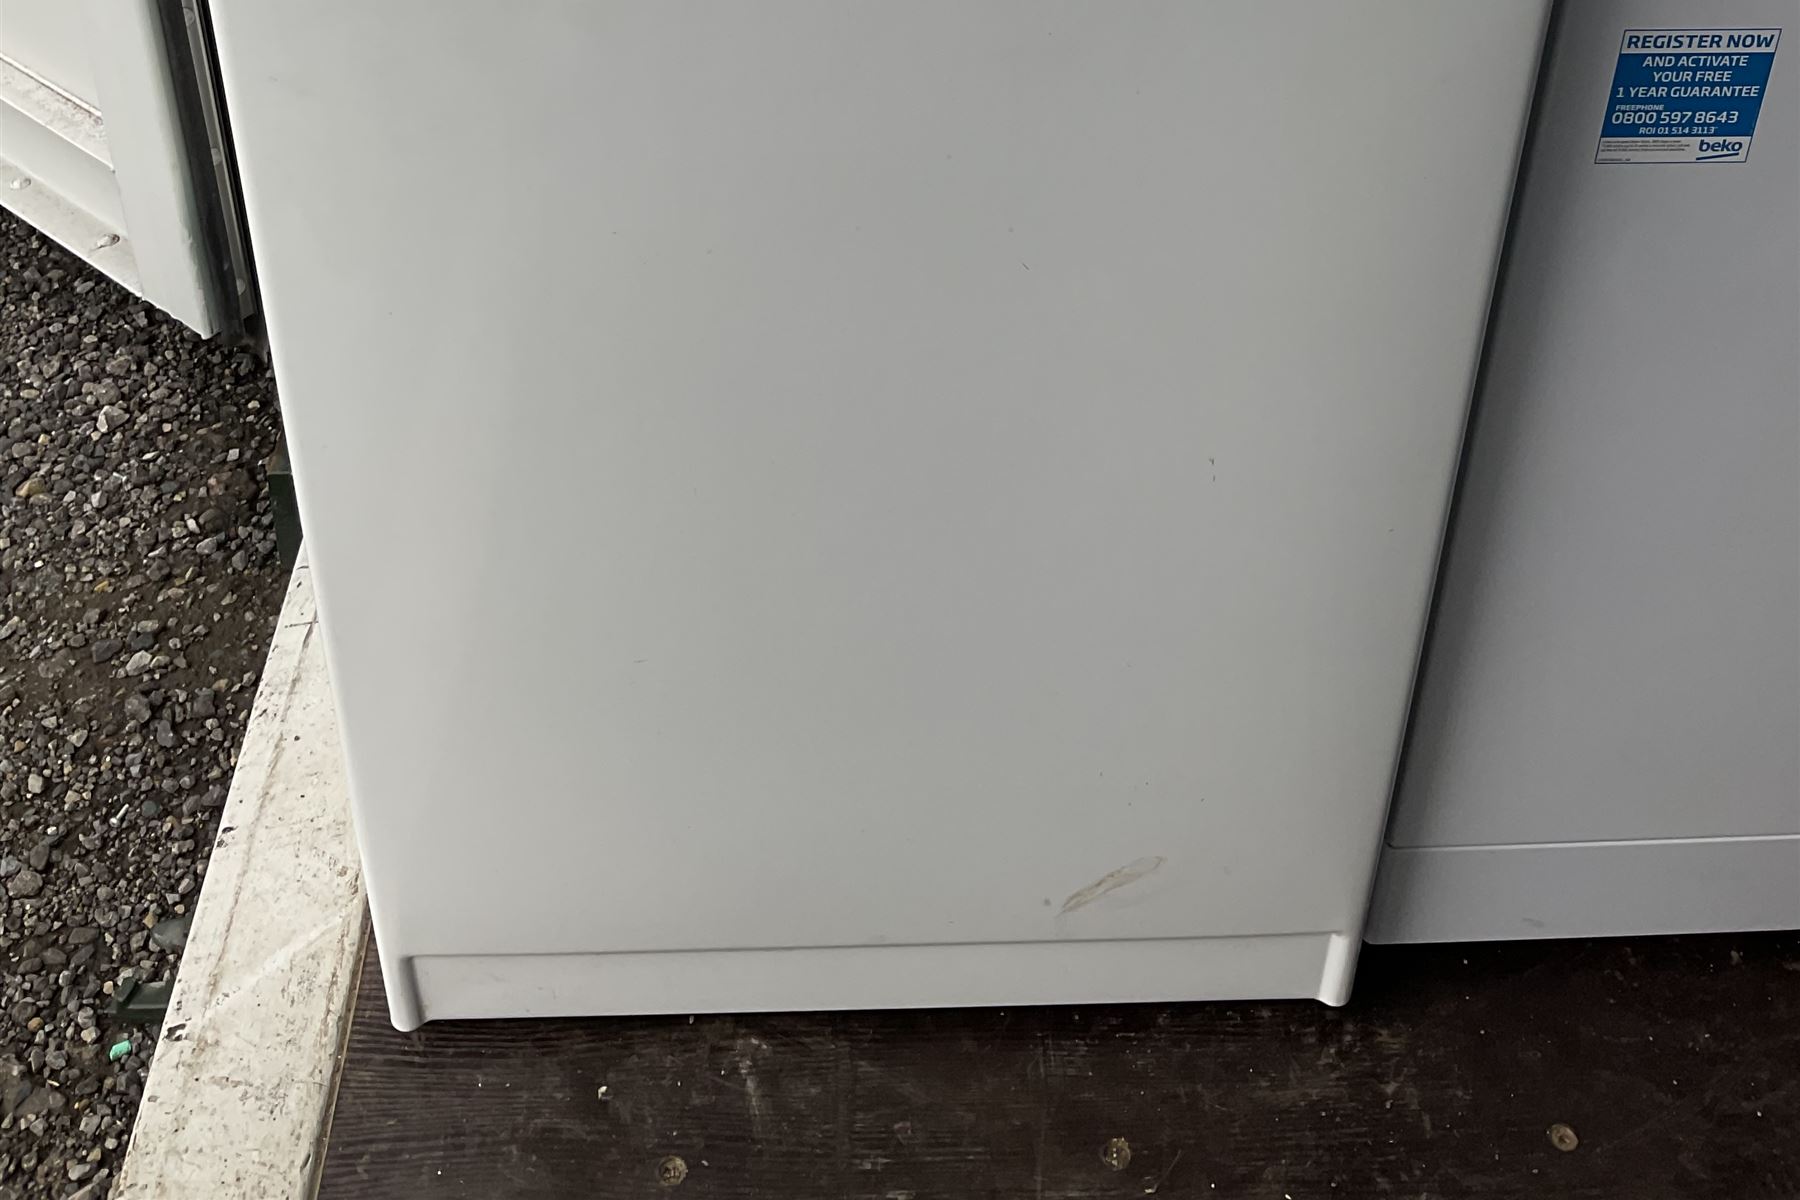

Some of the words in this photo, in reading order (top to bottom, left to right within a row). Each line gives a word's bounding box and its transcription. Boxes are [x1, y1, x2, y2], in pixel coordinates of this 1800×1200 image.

[1626, 34, 1723, 49] REGISTER
[1726, 34, 1775, 48] NOW
[1642, 56, 1675, 67] AND
[1677, 55, 1749, 67] ACTIVATE
[1653, 71, 1692, 82] YOUR
[1695, 71, 1733, 82] FREE
[1616, 87, 1624, 98] 1
[1629, 86, 1668, 98] YEAR
[1670, 86, 1760, 97] GUARANTEE
[1612, 112, 1657, 124] 0800
[1659, 112, 1691, 124] 597
[1694, 112, 1739, 123] 8643
[1639, 127, 1656, 135] ROI
[1657, 127, 1669, 135] 01
[1671, 127, 1689, 135] 514
[1698, 139, 1743, 152] beko
